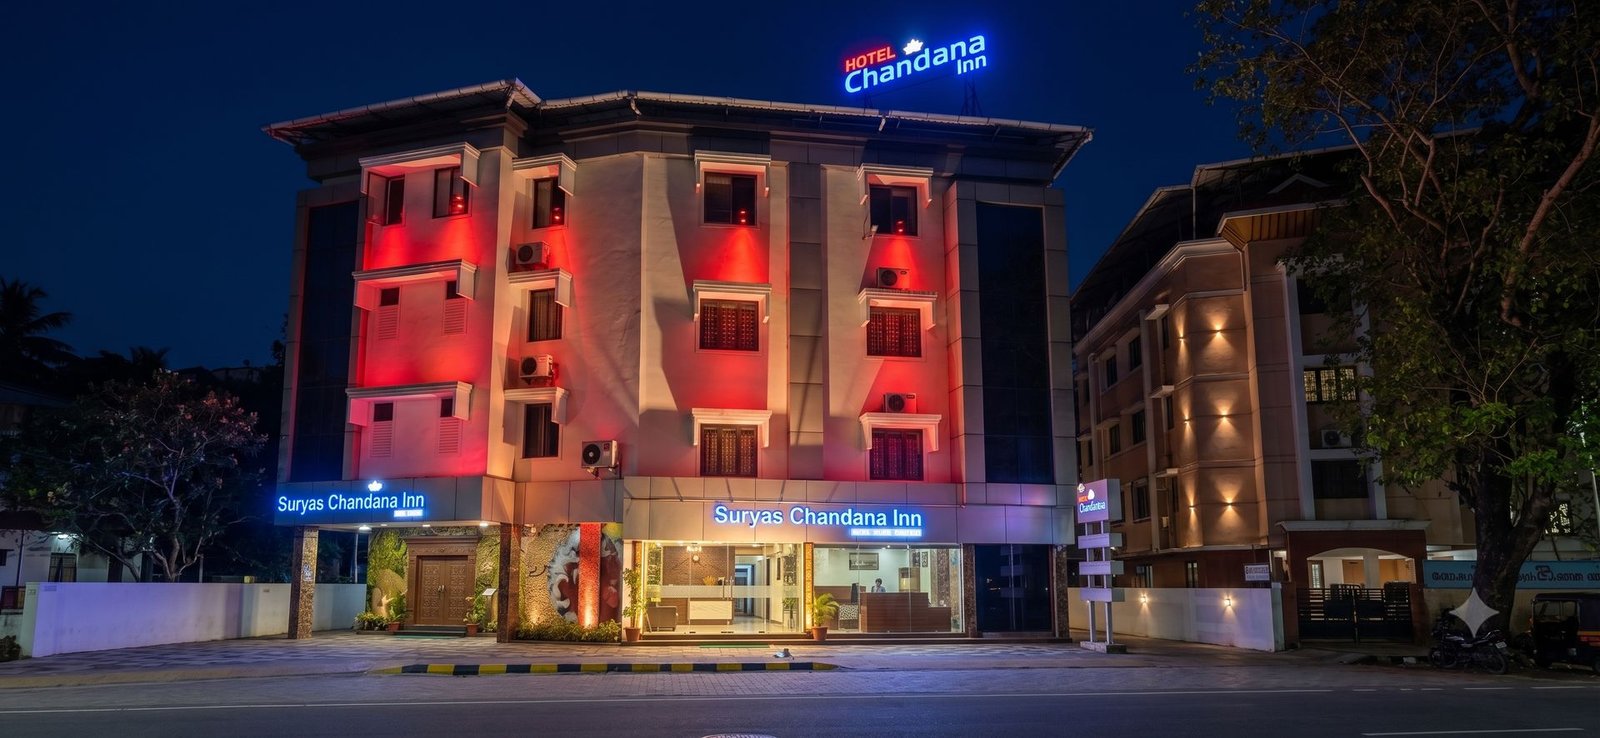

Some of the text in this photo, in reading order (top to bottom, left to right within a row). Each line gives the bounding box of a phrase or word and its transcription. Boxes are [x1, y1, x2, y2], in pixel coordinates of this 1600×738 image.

[844, 34, 986, 93] Chandana
[845, 46, 896, 72] HOTEL
[956, 55, 987, 75] Inn
[278, 491, 424, 515] Suryas Chandana Inn
[714, 505, 922, 528] Suryas Chandana Inn
